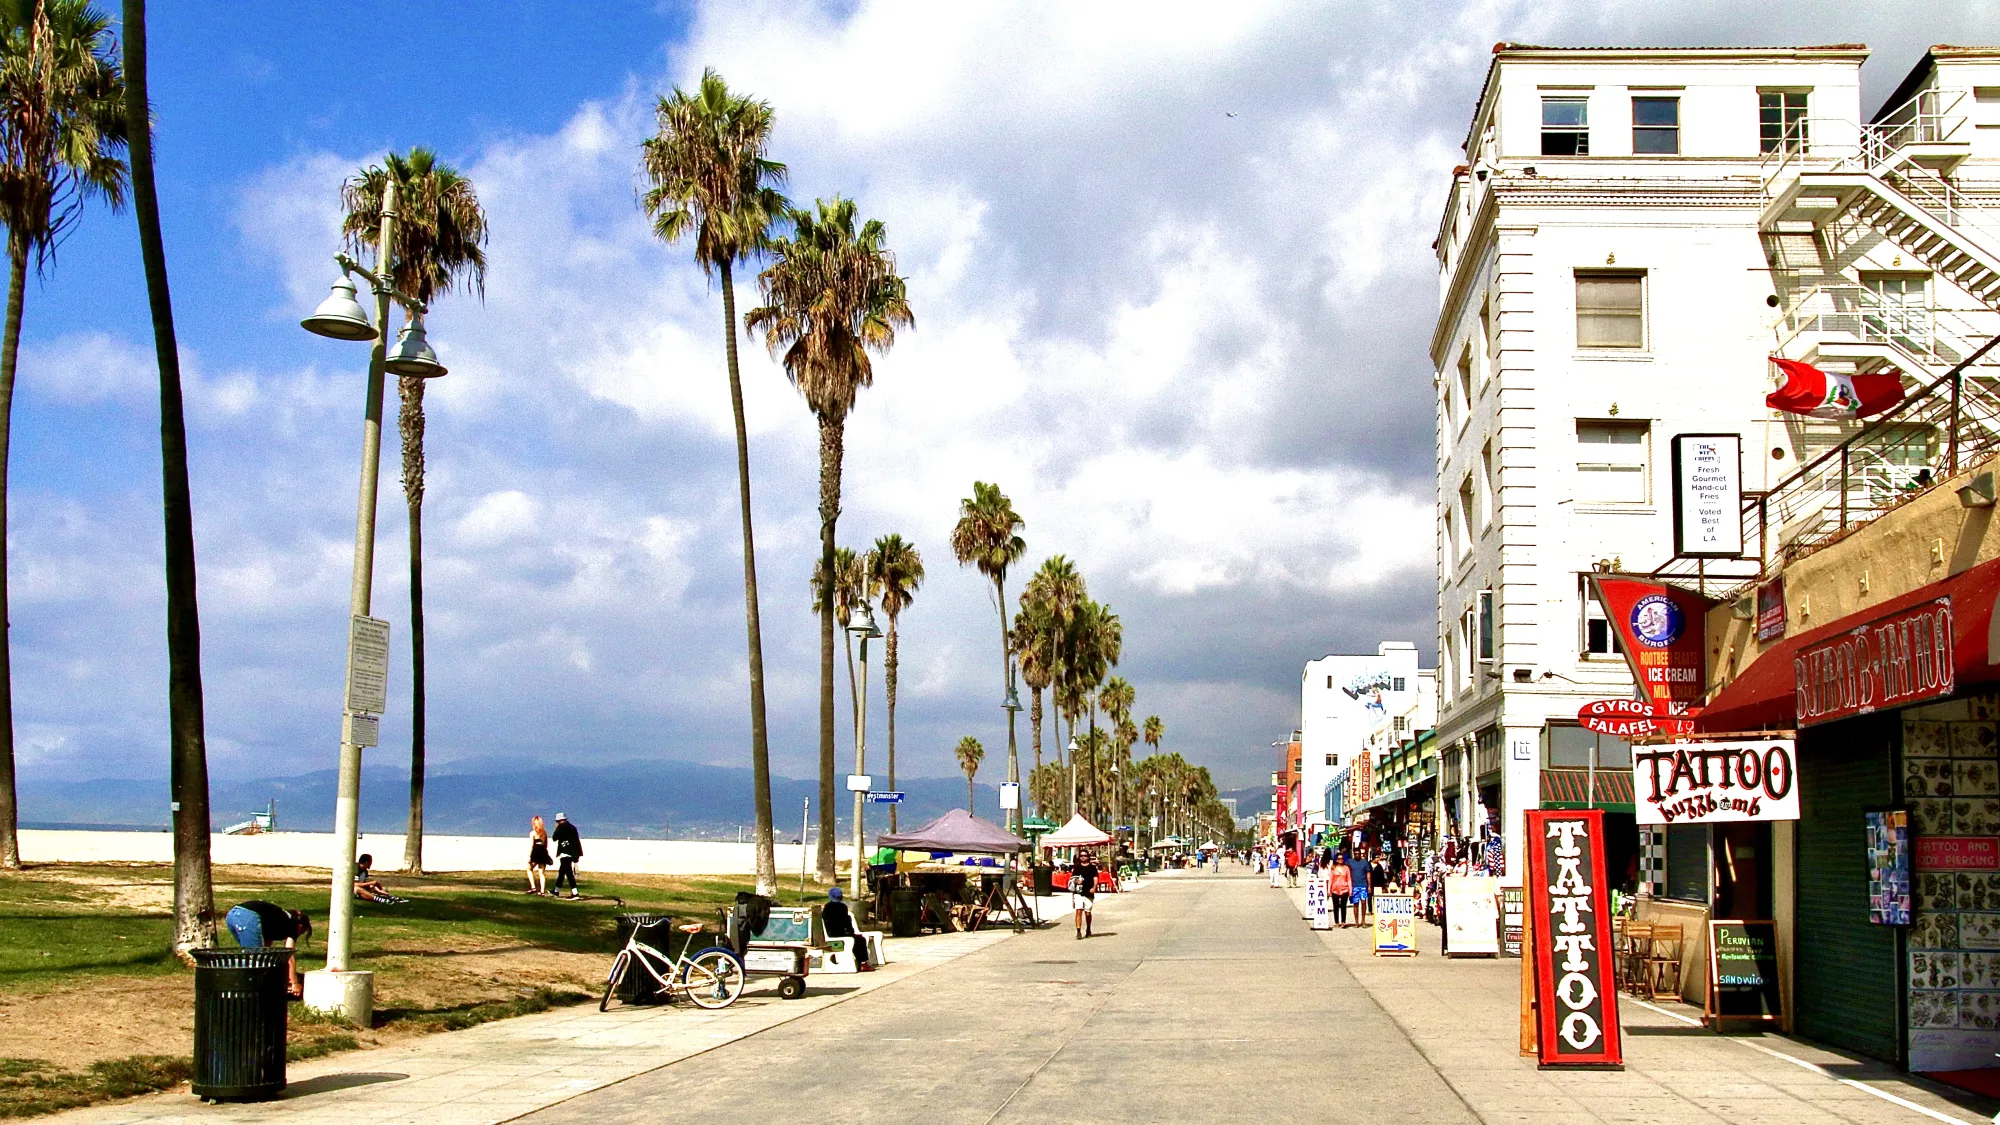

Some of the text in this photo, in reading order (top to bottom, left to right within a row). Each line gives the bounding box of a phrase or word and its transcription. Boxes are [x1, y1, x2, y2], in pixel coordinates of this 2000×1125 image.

[1637, 595, 1679, 611] AMERICAN
[1638, 634, 1676, 647] BURGER
[1640, 651, 1698, 665] ROOTBEER FLOATS
[1648, 667, 1696, 682] ICE CREAM
[1673, 684, 1697, 699] SHAKE
[1591, 700, 1655, 717] GYROS
[1588, 717, 1657, 735] FALAFEL
[1635, 746, 1793, 804] TATTOO
[1917, 842, 1990, 852] TATTOO AND
[1916, 855, 1994, 865] ODY PIERCING
[1308, 884, 1316, 906] ATM
[1317, 890, 1326, 915] ATM
[1376, 898, 1412, 914] PIZZA SLICE
[1546, 820, 1602, 1050] TATTOO
[1720, 928, 1764, 946] PERUVIAN
